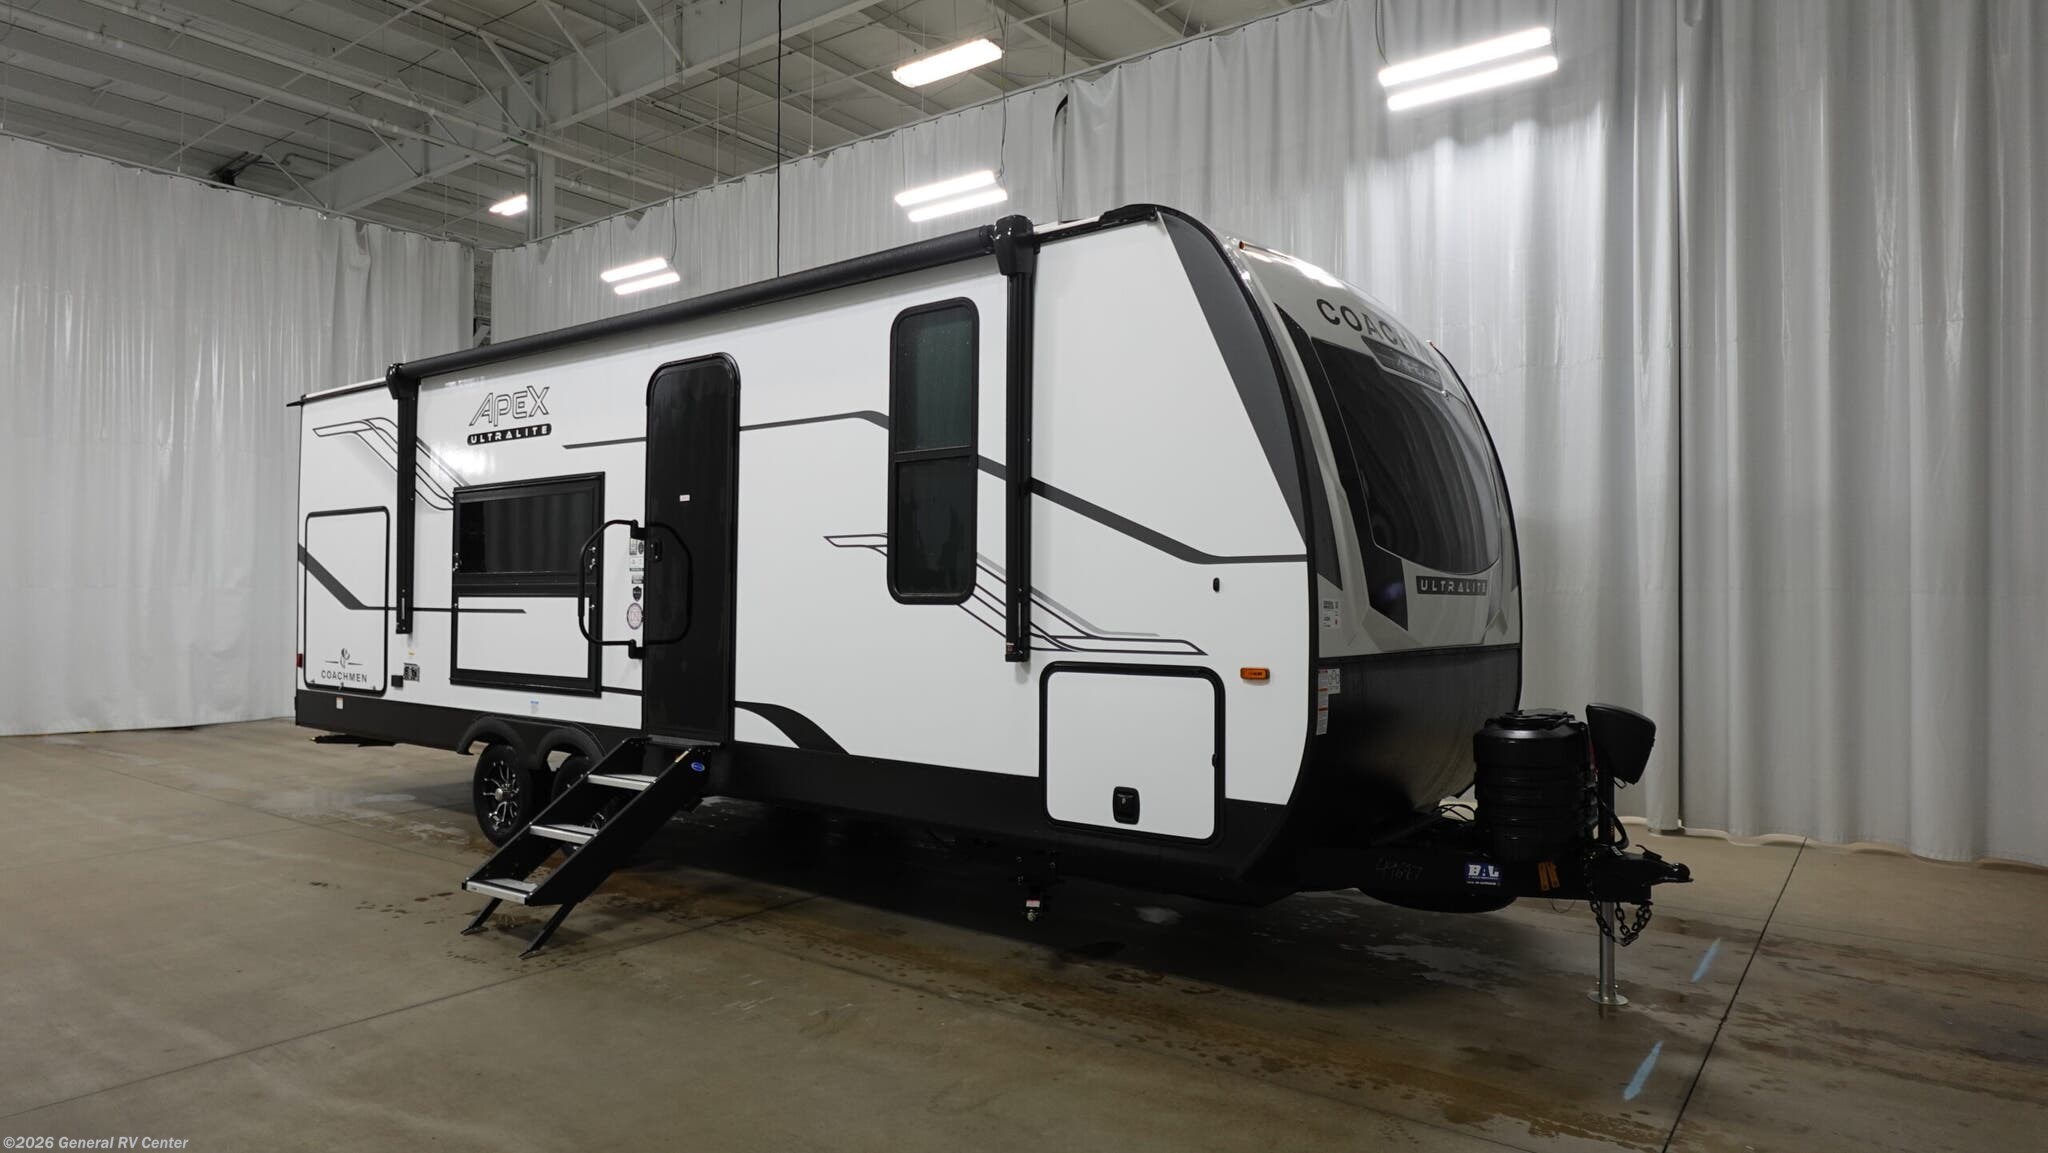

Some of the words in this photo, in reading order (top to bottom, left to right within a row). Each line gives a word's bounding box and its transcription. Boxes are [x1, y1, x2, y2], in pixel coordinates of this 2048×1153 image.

[469, 385, 549, 427] APEX
[470, 425, 548, 444] ULTRALITE
[1420, 578, 1486, 593] ULTRALITE
[321, 670, 367, 683] COACHMEN
[1468, 864, 1499, 877] BAL
